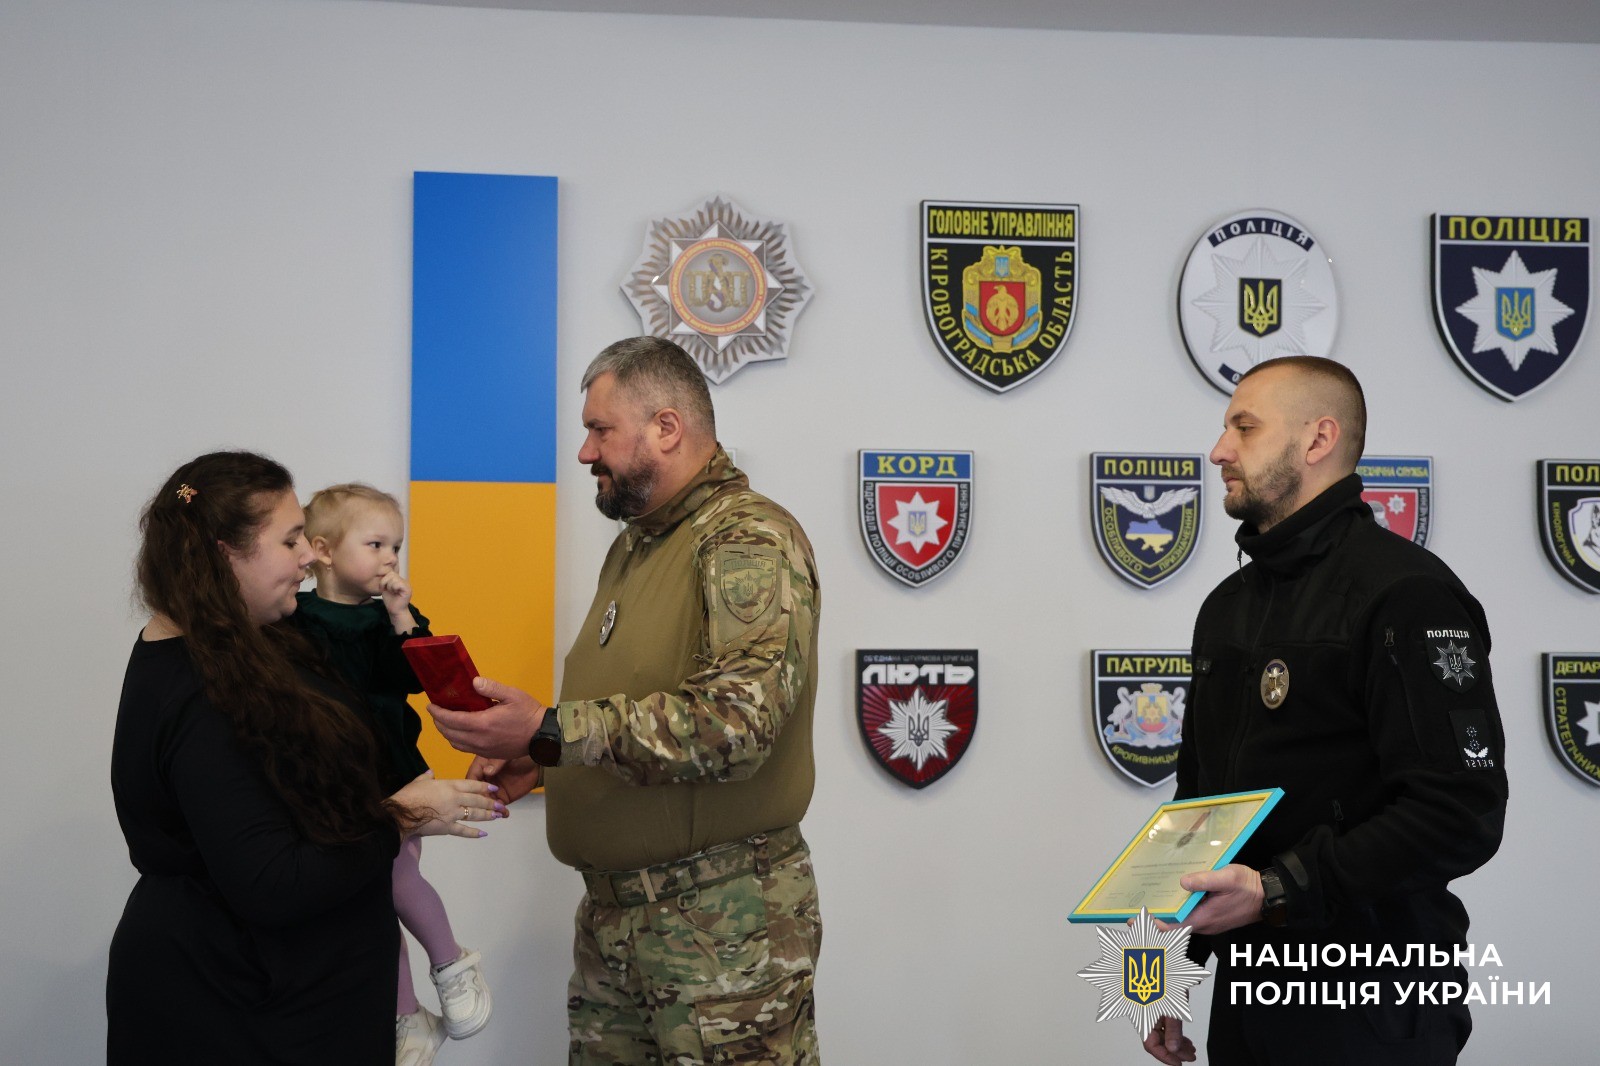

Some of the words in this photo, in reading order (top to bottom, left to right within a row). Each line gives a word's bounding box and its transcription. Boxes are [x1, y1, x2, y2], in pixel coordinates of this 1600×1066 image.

[929, 209, 988, 236] ГОЛОВНЕ
[991, 211, 1074, 238] УПРАВЛІННЯ
[1214, 220, 1308, 245] ПОЛІЦІЯ
[1448, 216, 1582, 242] ПОЛІЦІЯ
[930, 248, 1041, 376] КІРОВОГРАДСЬКА
[1039, 251, 1073, 349] ОБЛАСТЬ
[877, 455, 958, 477] КОРД
[1104, 459, 1194, 478] ПОЛІЦІЯ
[895, 550, 955, 580] ОСОБЛИВОГО
[952, 483, 969, 548] ПРИЗНАЧЕННЯ
[1105, 507, 1143, 571] ОСОБЛИВОГО
[1158, 508, 1193, 571] ПРИЗНАЧЕННЯ
[1426, 629, 1470, 639] ПОЛІЦІЯ
[862, 663, 975, 685] ЛЮТЬ
